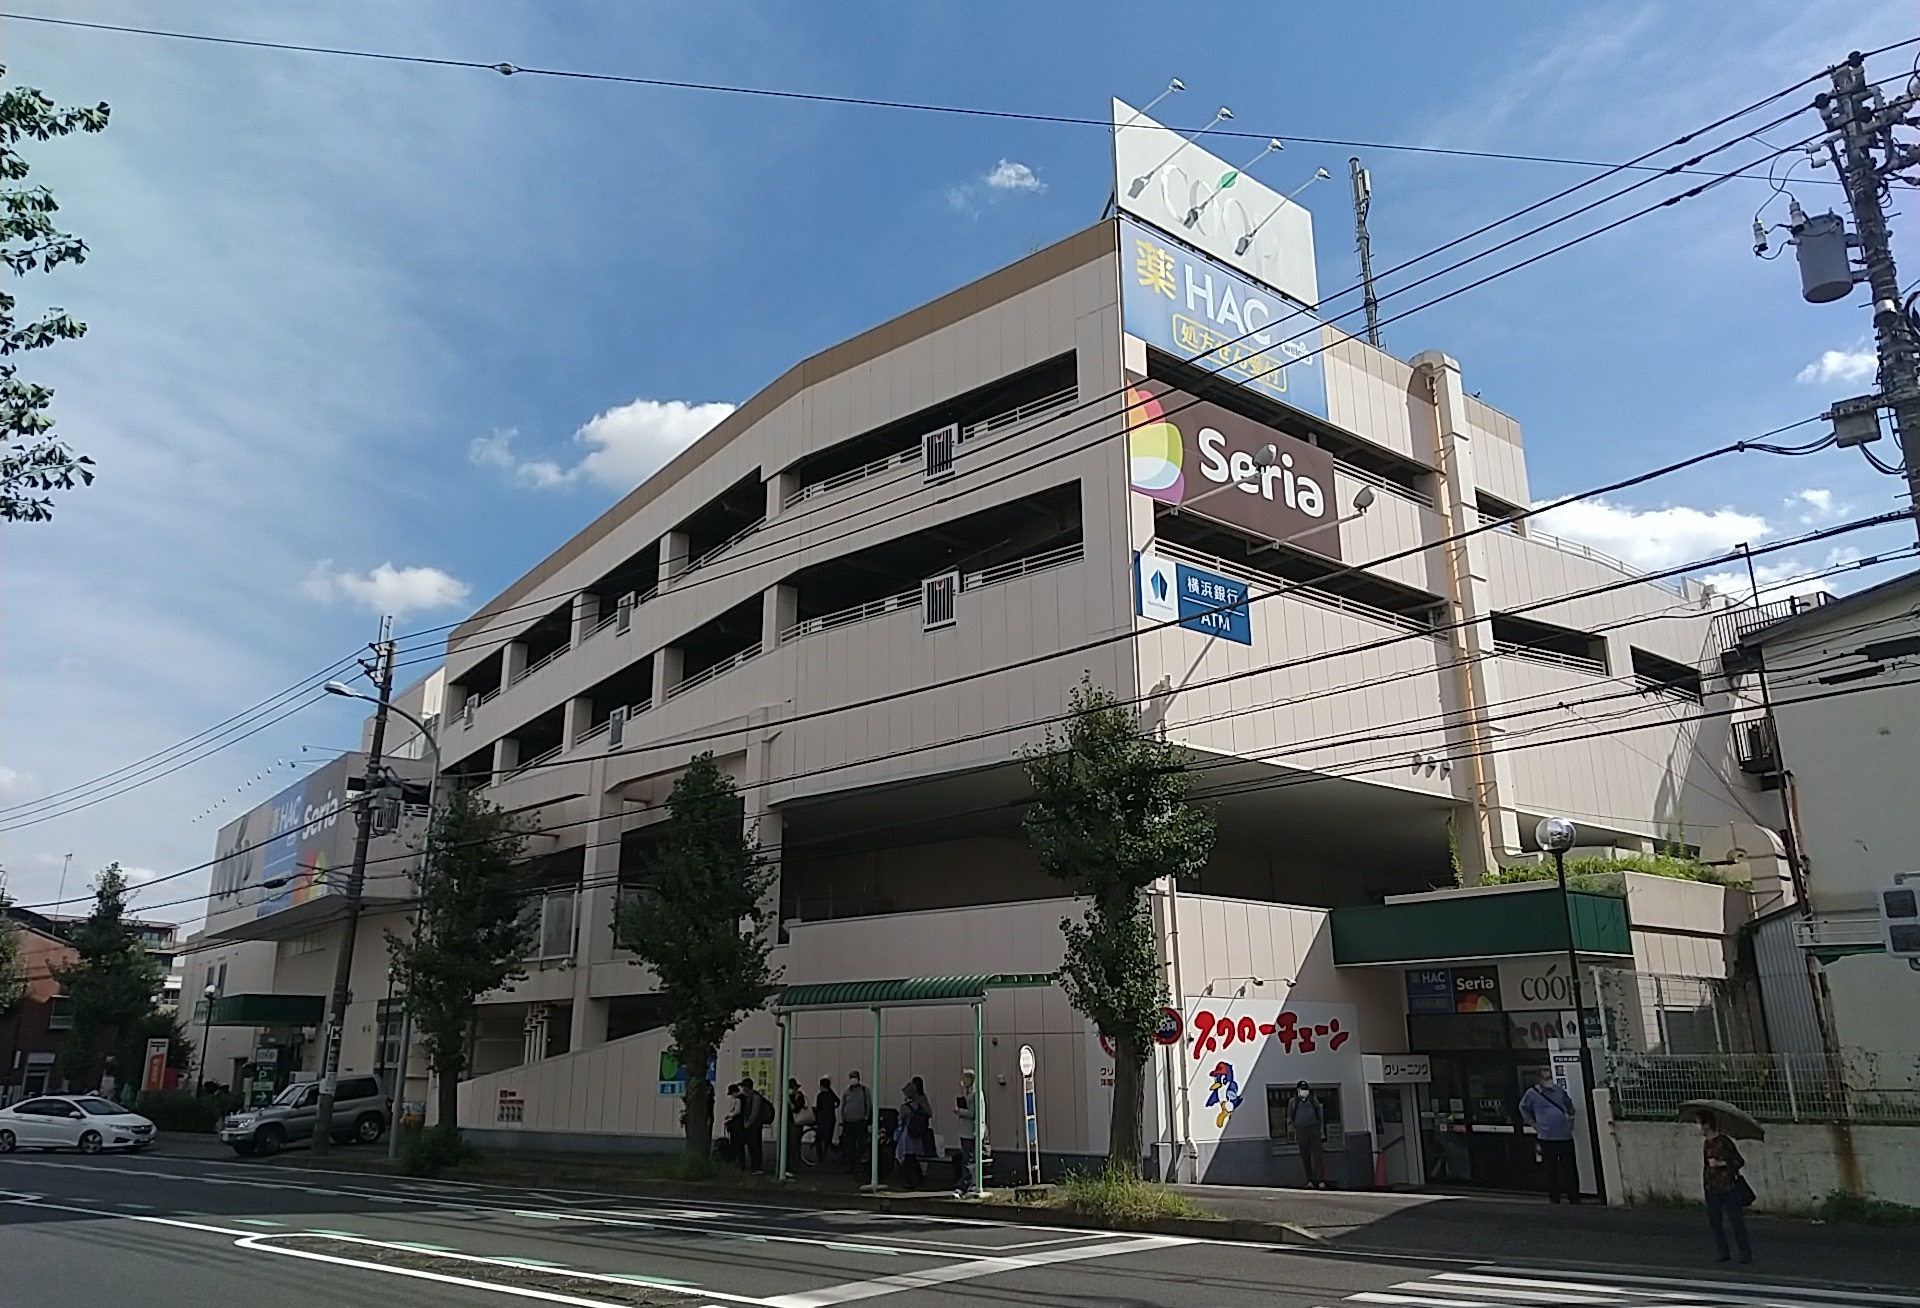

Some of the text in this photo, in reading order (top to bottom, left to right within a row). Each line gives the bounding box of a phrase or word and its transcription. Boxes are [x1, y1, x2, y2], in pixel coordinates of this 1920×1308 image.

[1136, 239, 1270, 345] 薬 HAC
[1180, 321, 1279, 386] 処方せん受付
[1198, 427, 1325, 518] Seria
[1187, 575, 1239, 605] 横浜銀行
[1201, 611, 1231, 632] ATM
[280, 795, 302, 833] HAC
[302, 789, 339, 840] Seria
[1422, 971, 1446, 984] HAC
[1456, 976, 1494, 991] Seria
[1193, 1010, 1349, 1060] スクローチェーン
[1384, 1064, 1428, 1076] クリーニング
